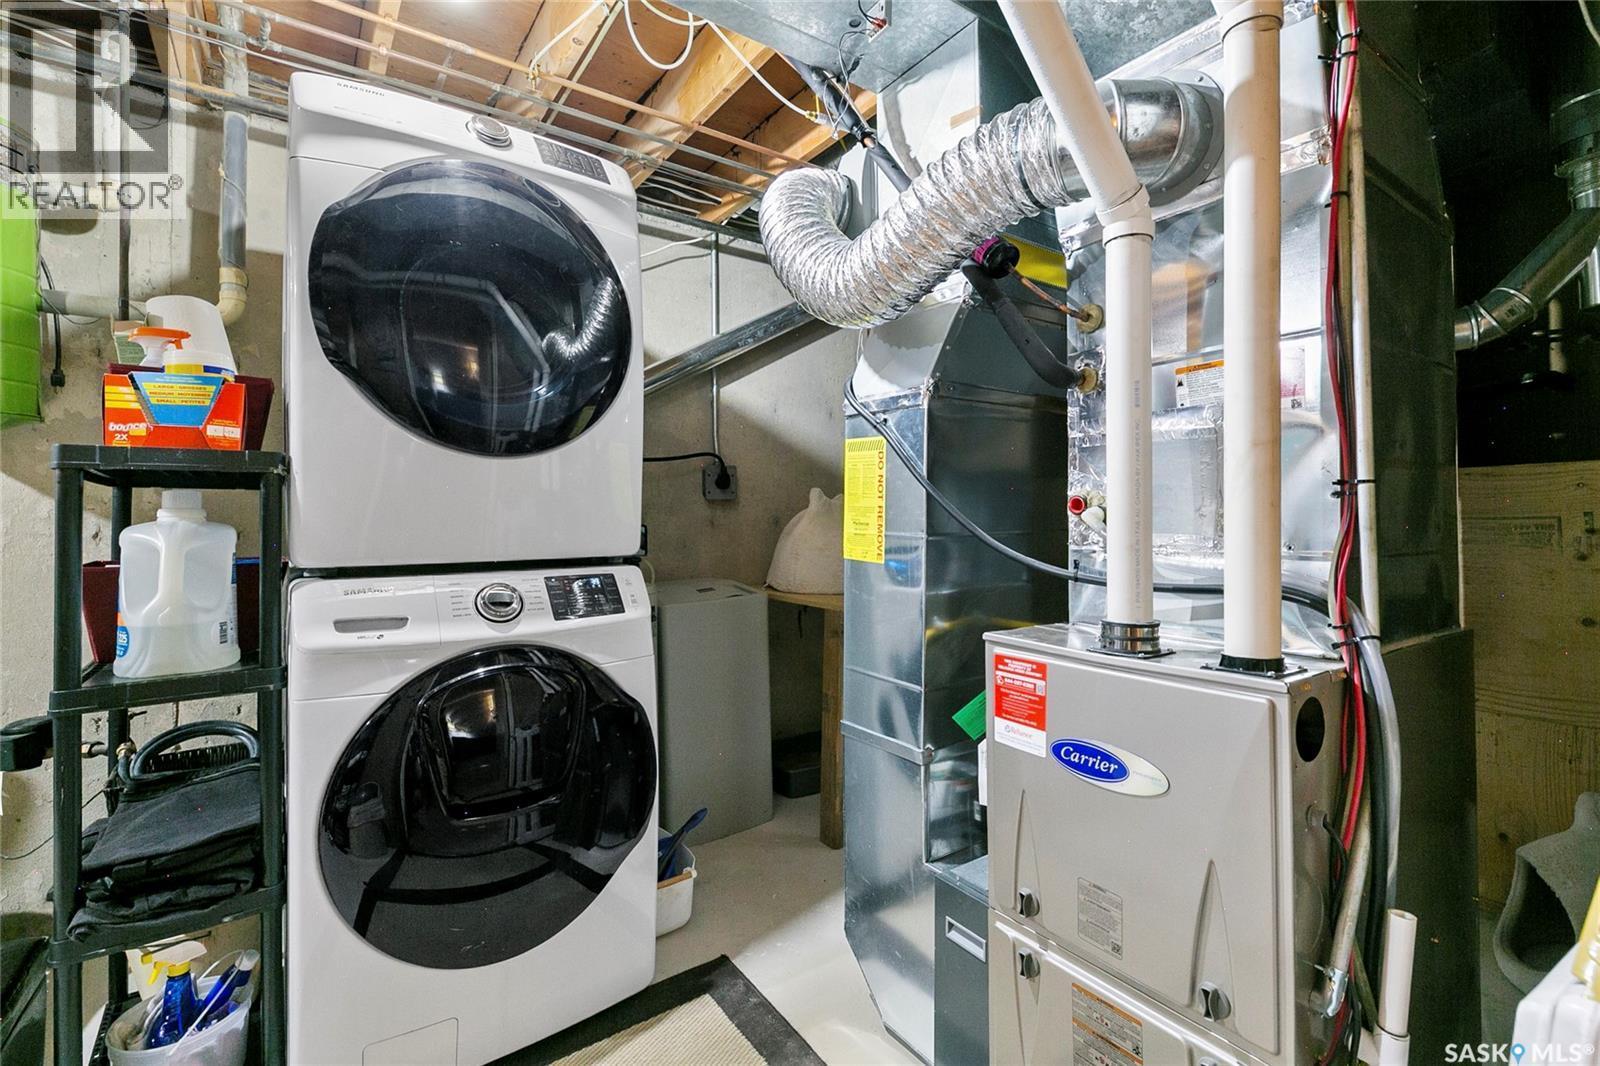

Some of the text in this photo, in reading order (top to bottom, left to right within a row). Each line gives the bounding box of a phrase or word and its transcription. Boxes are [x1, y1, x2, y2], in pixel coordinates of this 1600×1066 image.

[108, 422, 147, 432] bounce
[114, 433, 128, 441] 2X
[878, 451, 884, 470] DO
[876, 505, 884, 561] REMOVE
[1060, 746, 1118, 774] Carrier
